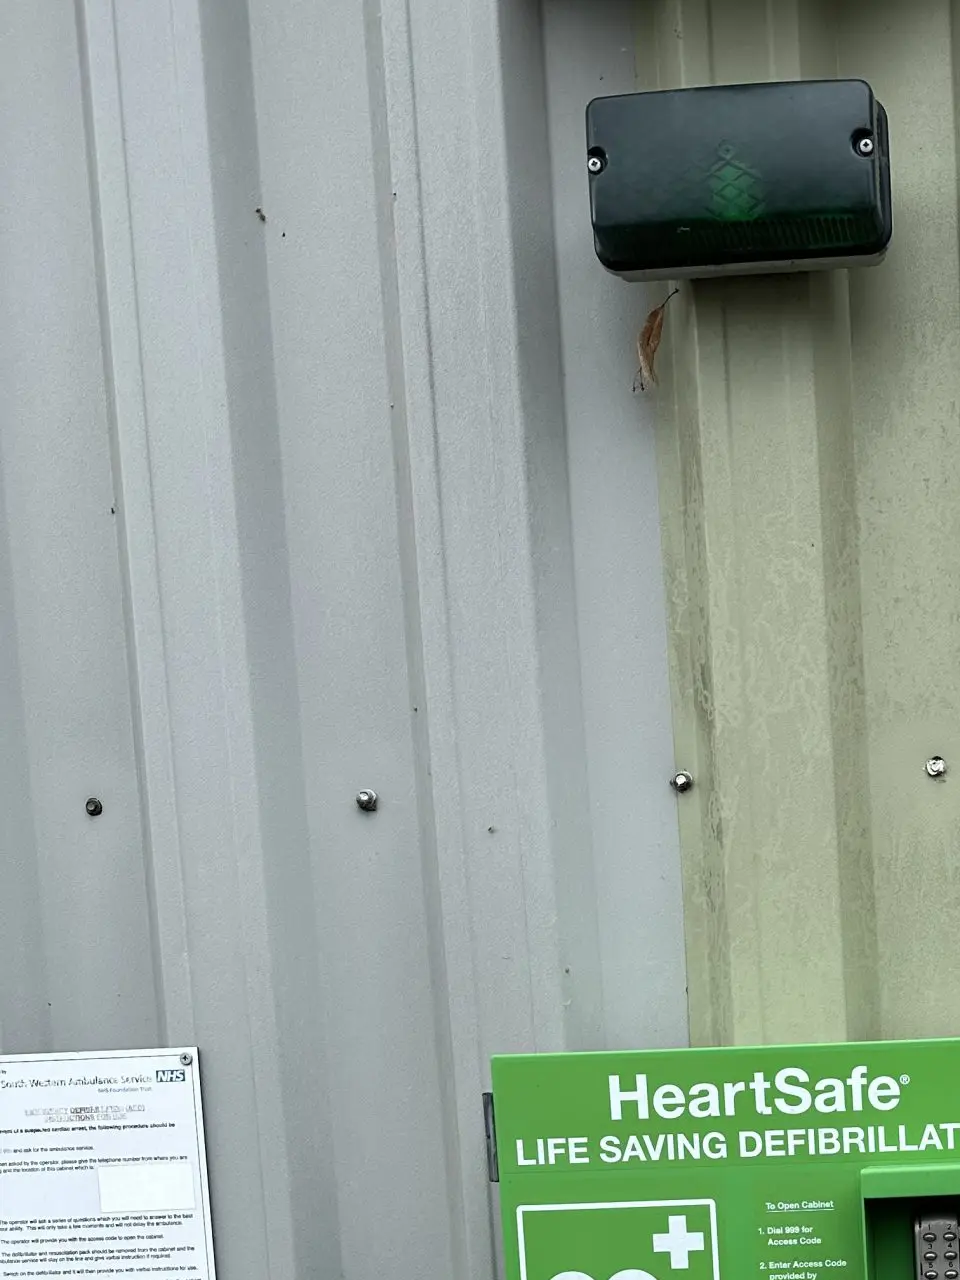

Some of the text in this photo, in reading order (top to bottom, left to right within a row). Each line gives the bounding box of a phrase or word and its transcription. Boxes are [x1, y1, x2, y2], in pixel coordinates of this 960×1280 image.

[156, 1070, 186, 1082] NHS
[516, 1136, 590, 1166] LIFE
[600, 1132, 728, 1163] SAVING
[766, 1200, 834, 1212] To Open Cabinet
[785, 1226, 800, 1234] 999
[801, 1225, 813, 1233] for
[768, 1238, 797, 1246] Access
[769, 1261, 791, 1269] Enter
[793, 1260, 823, 1268] Access
[825, 1259, 847, 1267] Code
[807, 1272, 817, 1280] by
